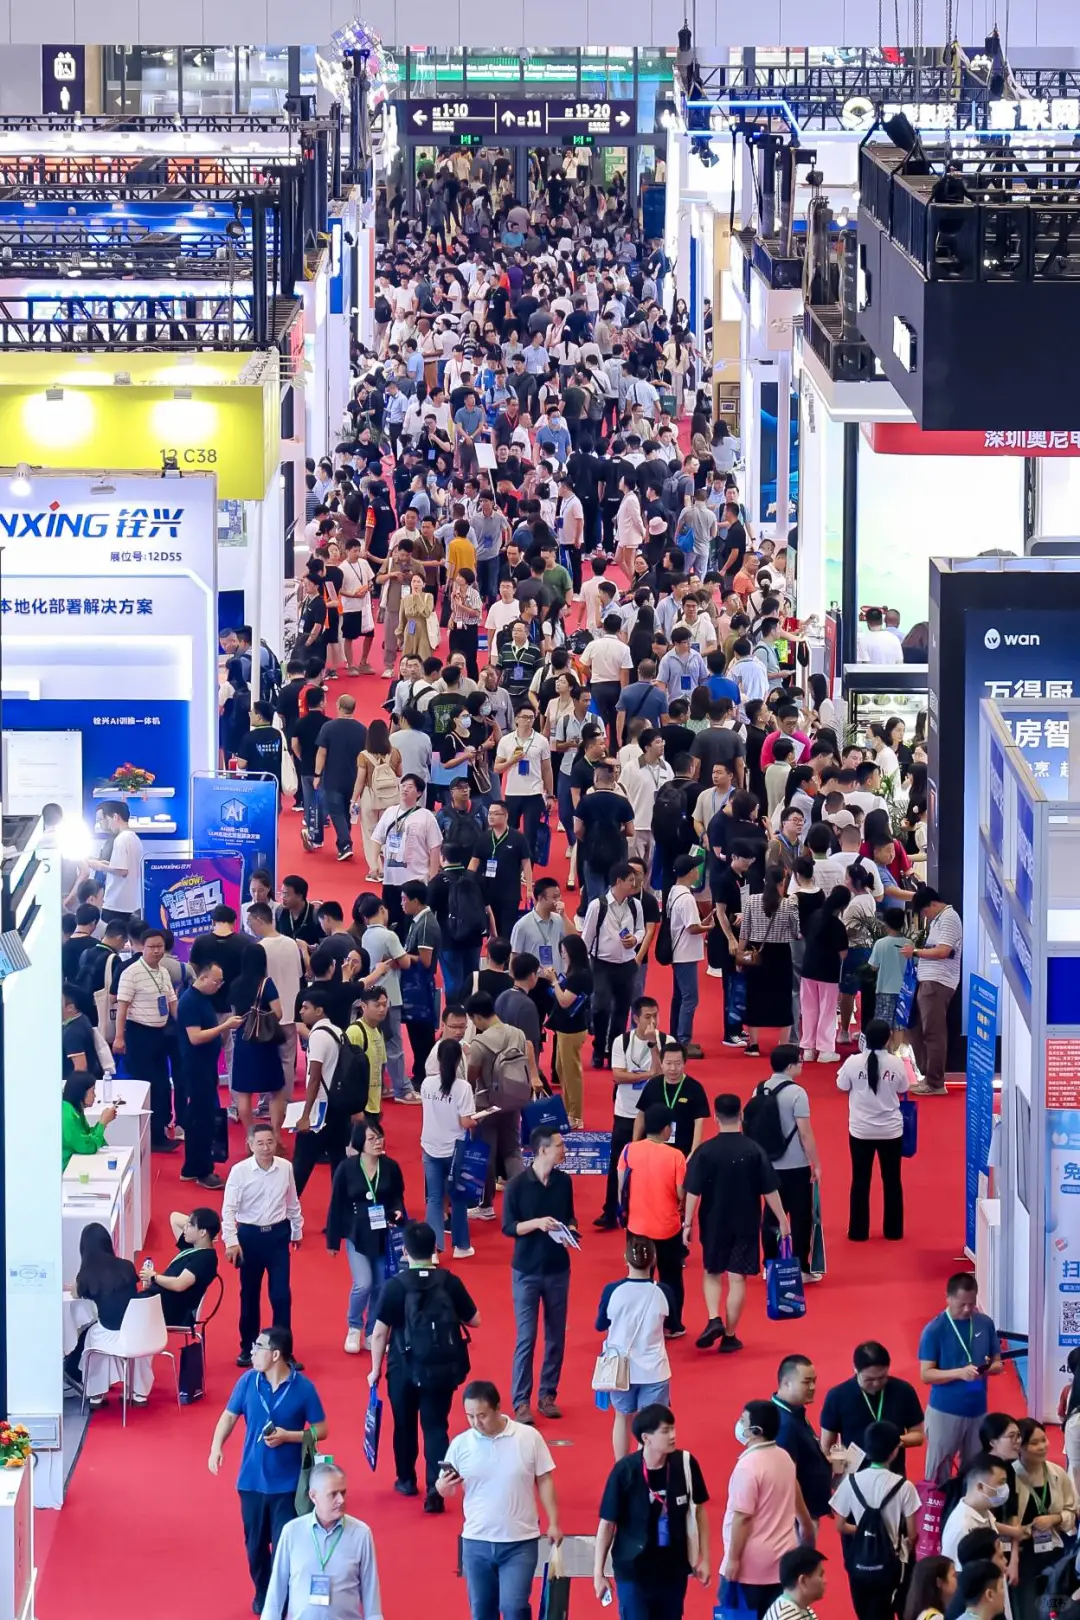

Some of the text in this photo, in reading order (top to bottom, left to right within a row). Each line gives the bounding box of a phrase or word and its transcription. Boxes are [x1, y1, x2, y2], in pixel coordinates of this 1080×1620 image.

[527, 110, 541, 127] 11
[184, 449, 217, 463] C38
[0, 598, 153, 614] 本地化部署解决方案
[1004, 634, 1040, 646] wan
[1003, 719, 1070, 749] 房智
